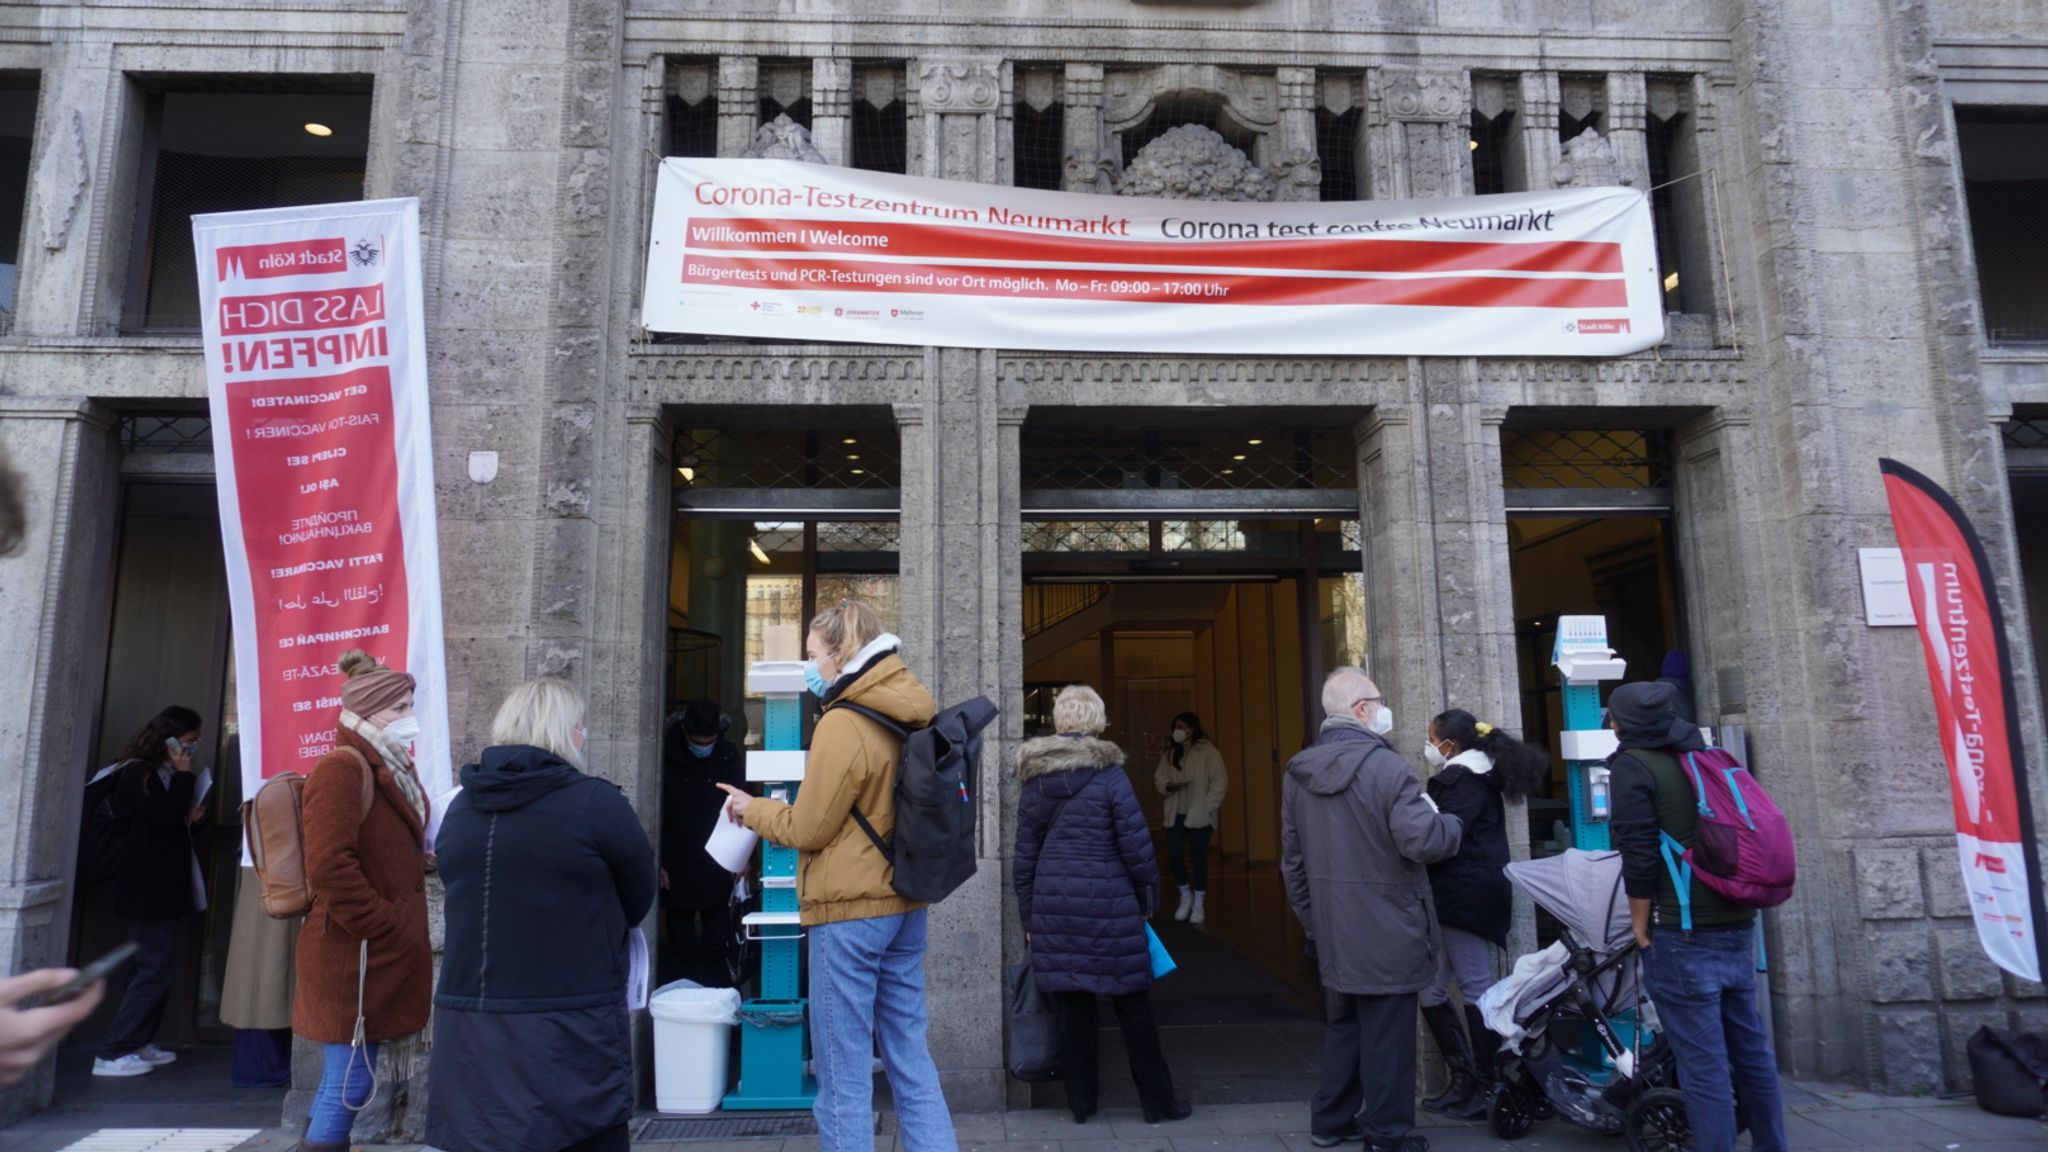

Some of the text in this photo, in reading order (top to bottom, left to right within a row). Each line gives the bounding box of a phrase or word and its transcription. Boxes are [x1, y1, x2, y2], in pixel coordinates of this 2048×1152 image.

[694, 181, 1131, 236] Corona-Testzentrum Neumarkt
[1161, 216, 1260, 240] Corona
[1267, 221, 1319, 237] test
[1419, 208, 1555, 232] Neumarkt
[692, 226, 796, 245] Willkommen
[809, 230, 889, 248] Welcome
[687, 263, 767, 284] Bürgertests
[771, 267, 797, 282] und
[800, 268, 901, 287] PCR-Testungen
[904, 273, 933, 287] sind
[936, 276, 960, 287] vor
[962, 273, 986, 289] Ort
[988, 275, 1049, 293] möglich.
[1204, 283, 1230, 297] Uhr
